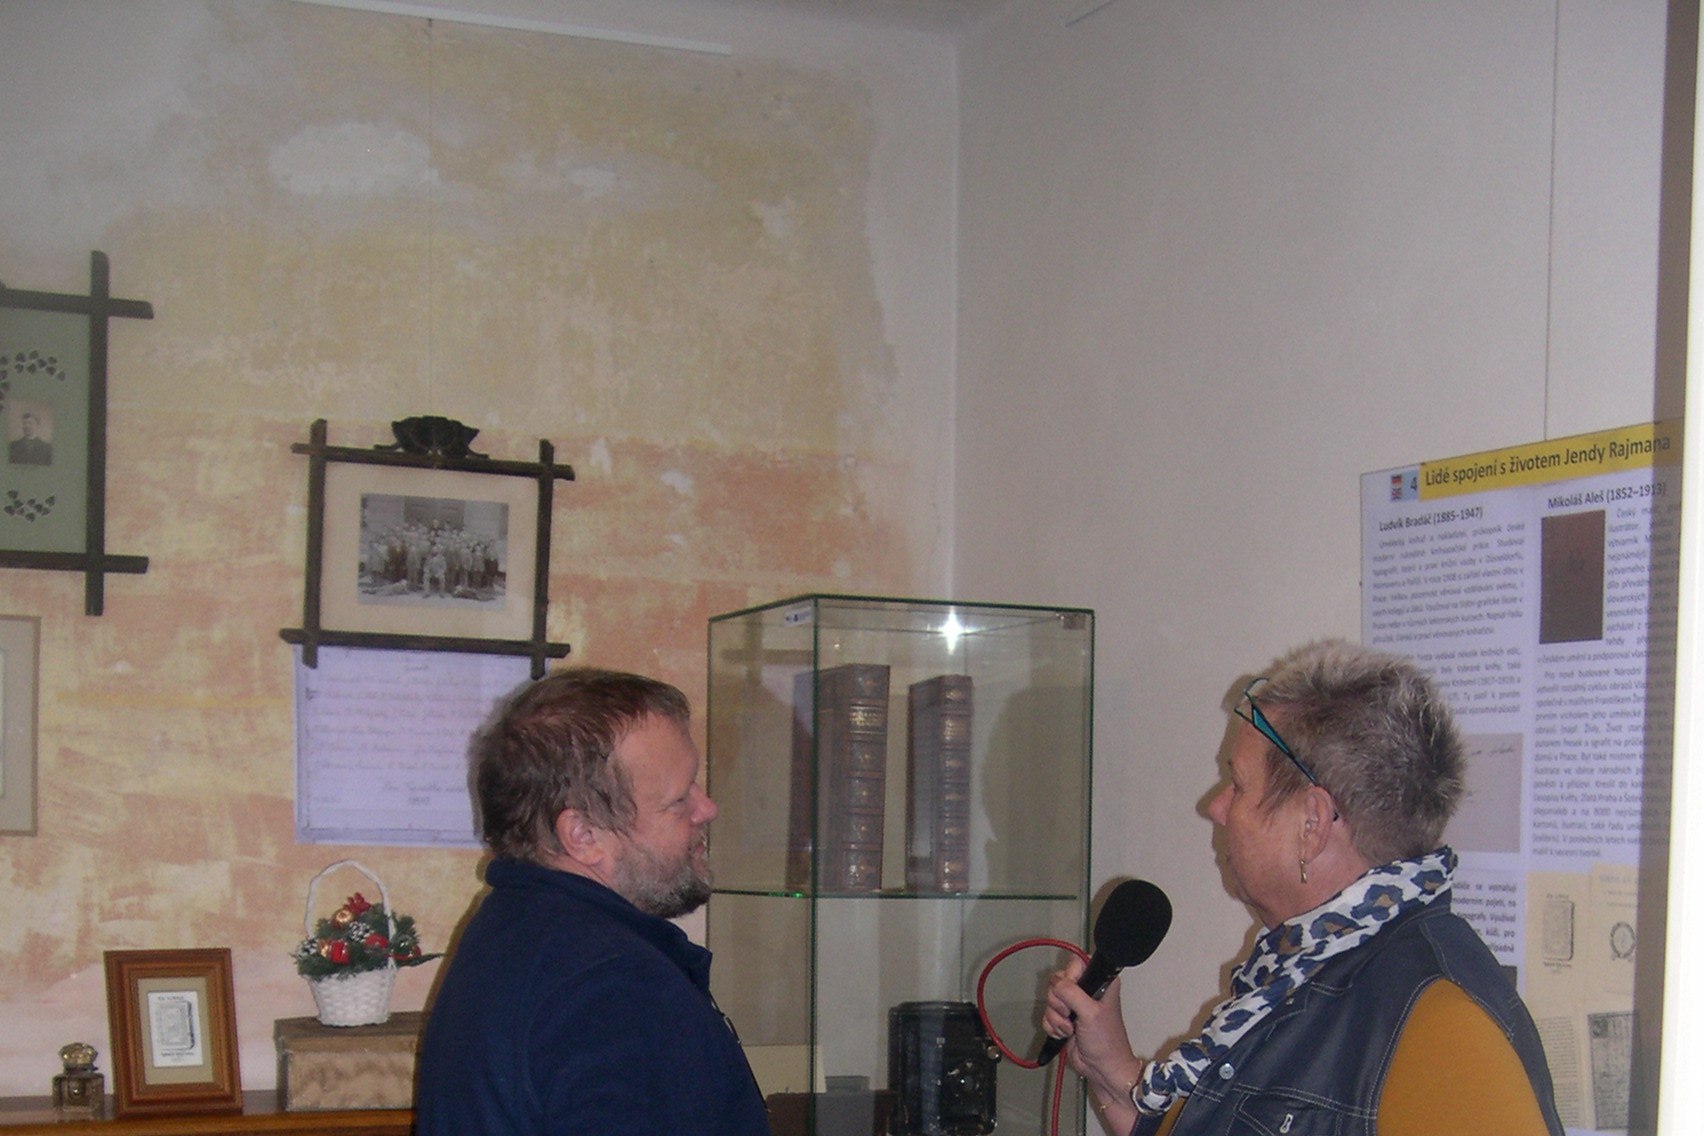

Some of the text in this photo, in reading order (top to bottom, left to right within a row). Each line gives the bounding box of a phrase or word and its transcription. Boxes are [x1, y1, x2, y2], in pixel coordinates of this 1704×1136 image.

[1410, 434, 1670, 491] 4 Lidé spojení s životem Jendy Rajmana
[1547, 492, 1583, 509] Mikoláš
[1584, 488, 1604, 505] Aleš
